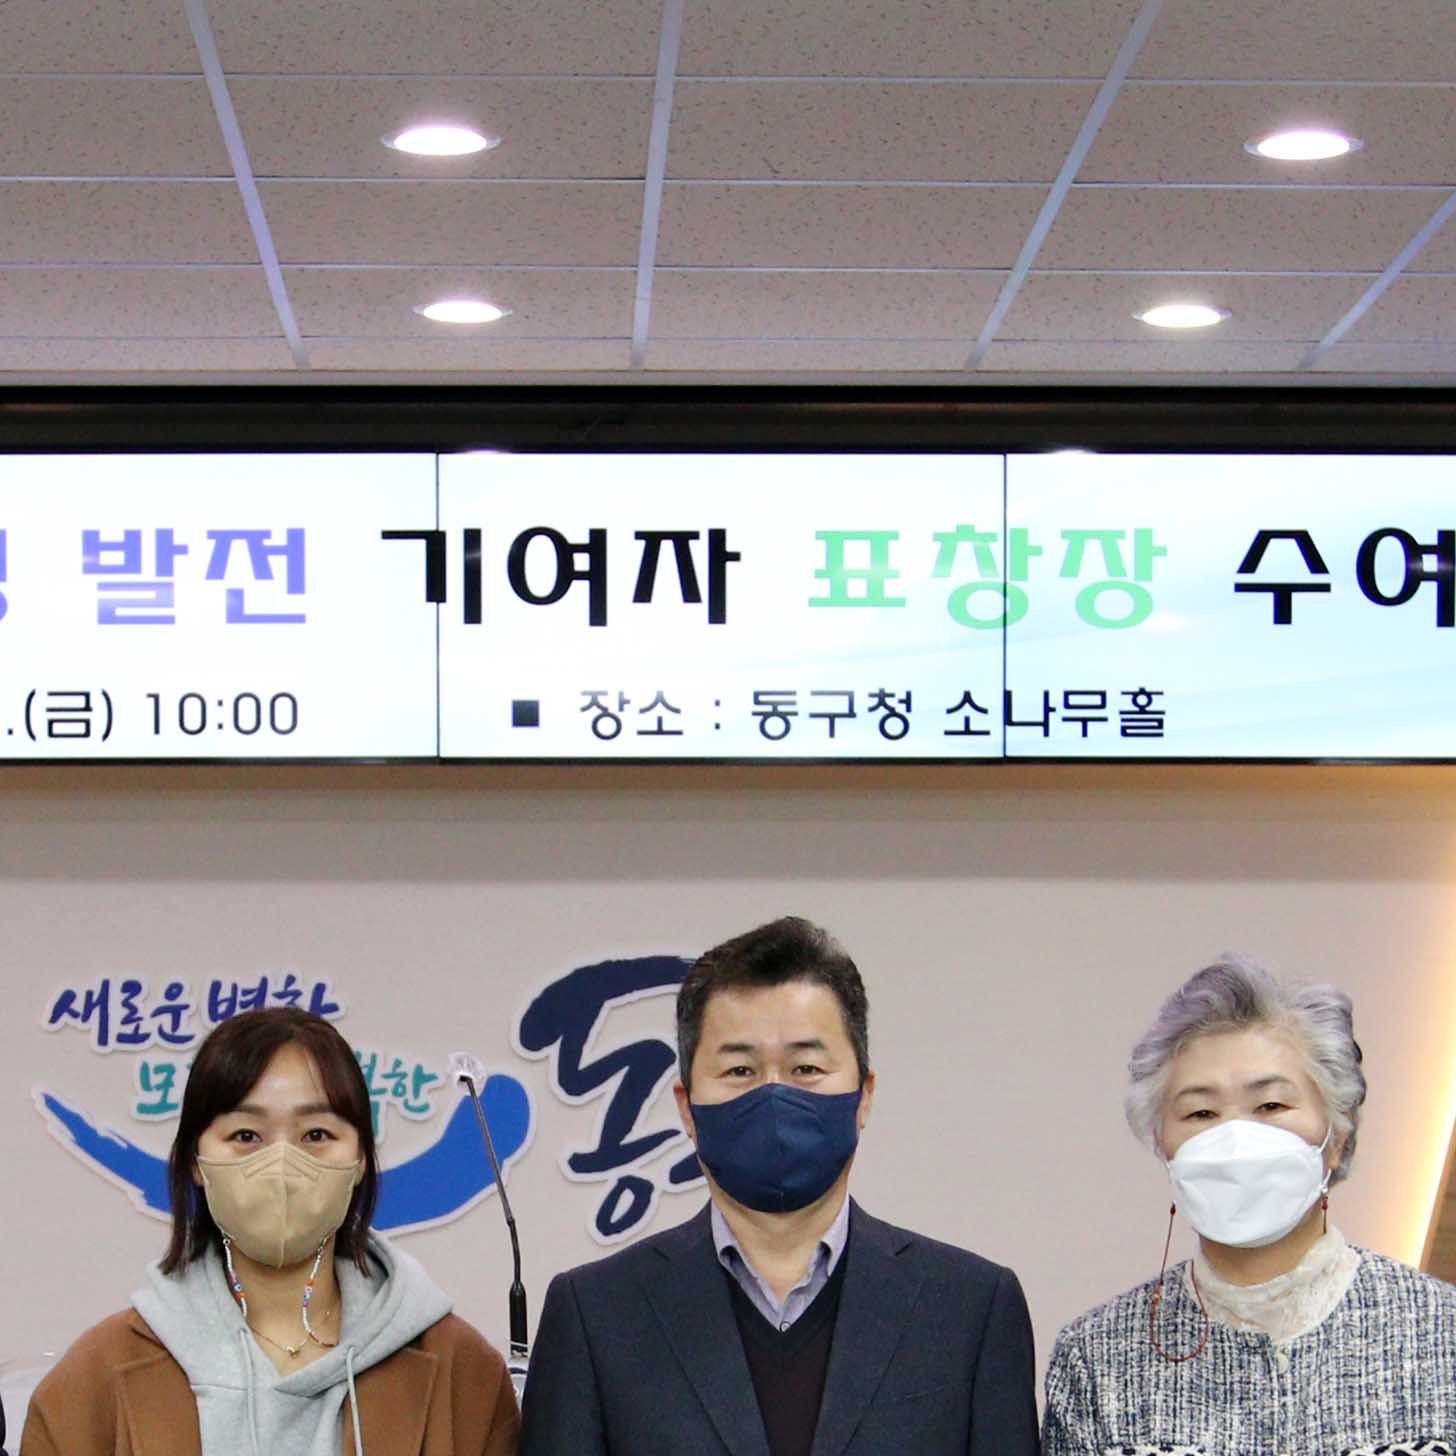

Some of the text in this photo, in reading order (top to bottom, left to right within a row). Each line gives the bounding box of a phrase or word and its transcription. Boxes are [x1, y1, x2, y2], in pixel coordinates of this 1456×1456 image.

[81, 527, 307, 627] 발전
[380, 527, 742, 628] 기여자
[808, 525, 1168, 630] 표창장
[146, 692, 299, 737] 10:00
[580, 691, 684, 742] 장소
[751, 688, 913, 742] 동구청
[943, 688, 1167, 742] 소나무홀
[47, 978, 195, 1046] 새로운
